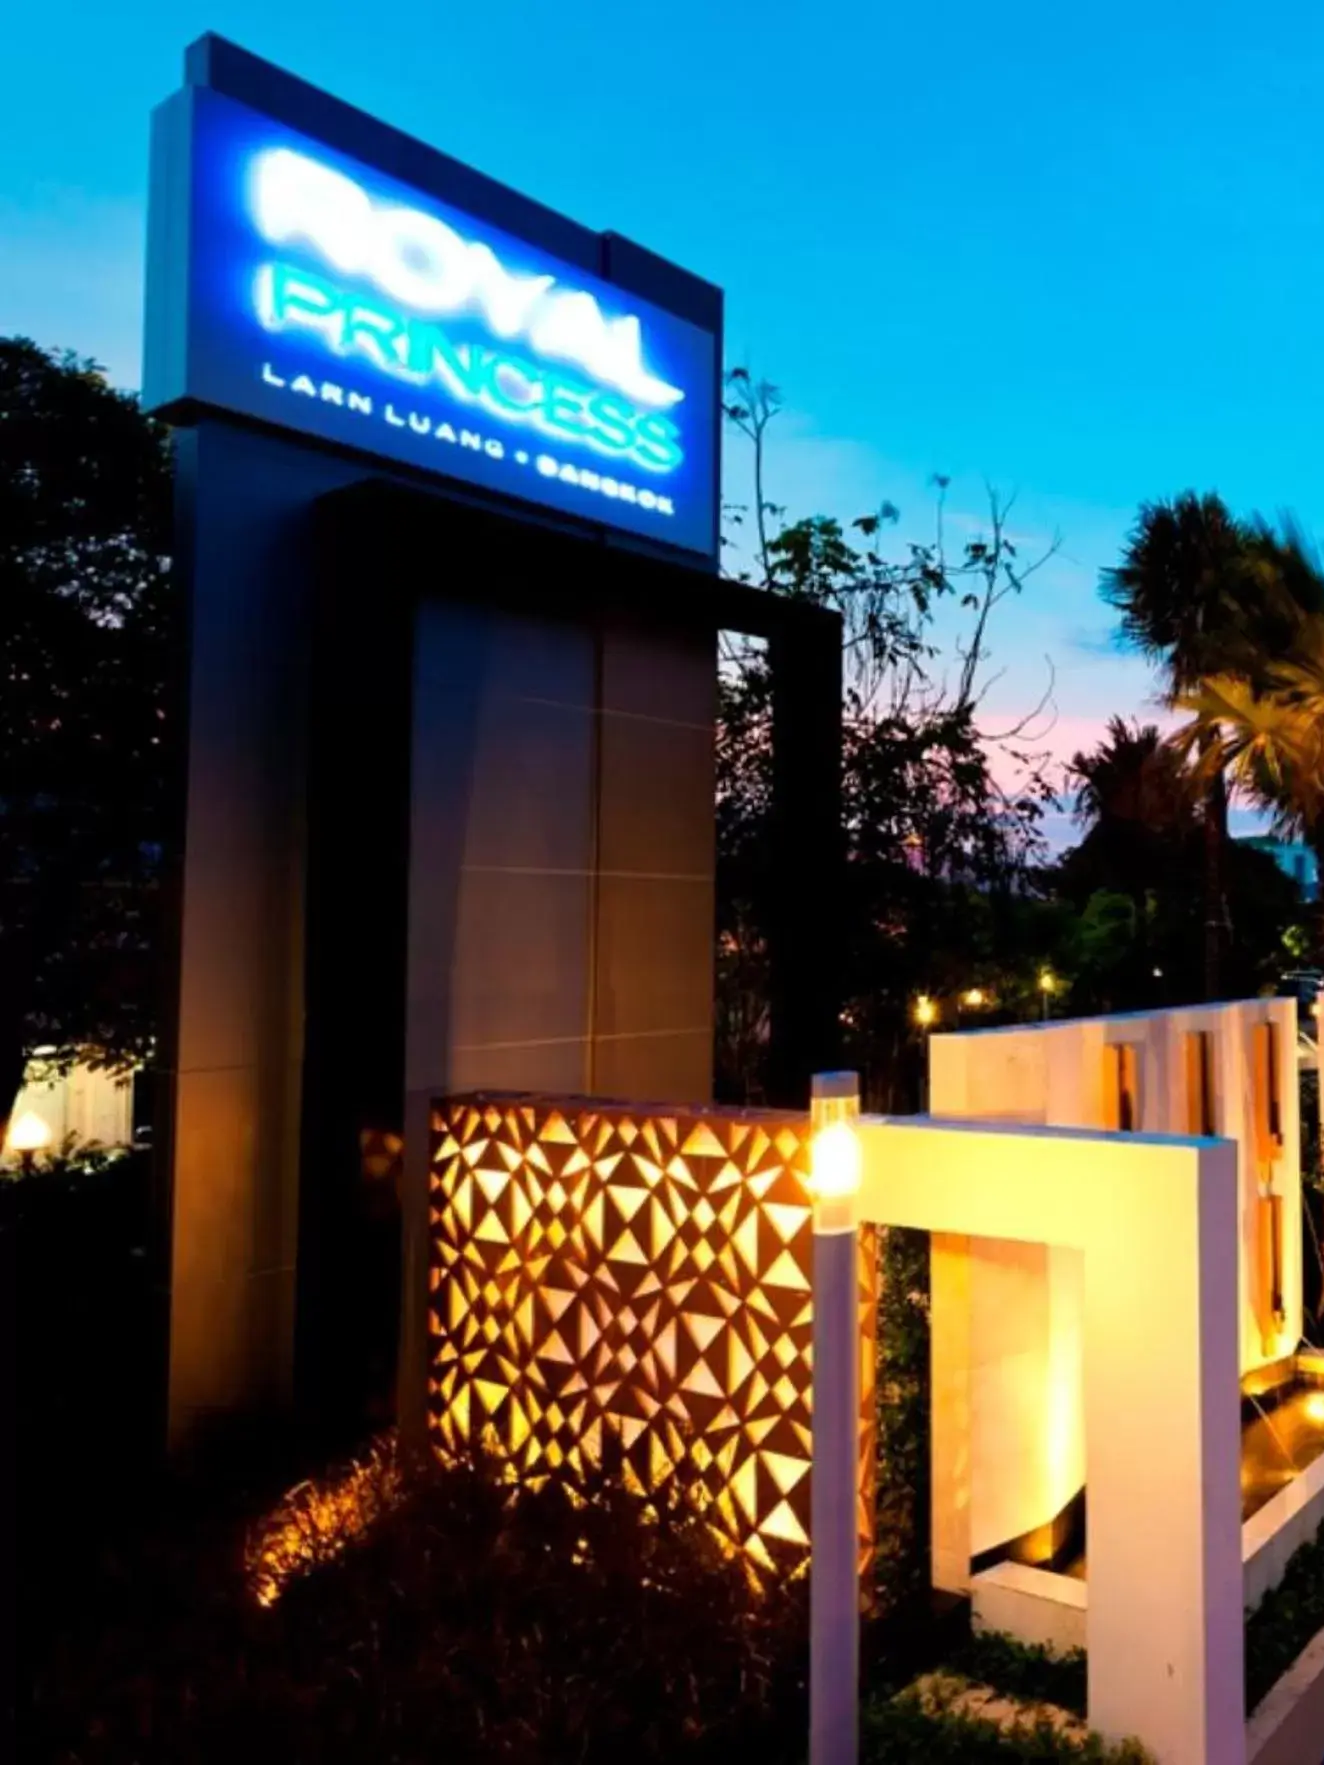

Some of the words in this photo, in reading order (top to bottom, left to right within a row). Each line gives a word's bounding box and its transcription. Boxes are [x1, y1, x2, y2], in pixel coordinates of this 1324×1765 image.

[245, 147, 685, 406] ROYAL
[257, 261, 685, 472] PRINCESS
[262, 362, 373, 416] LARN
[384, 404, 505, 460] LUANG
[535, 453, 676, 516] BANGKOK
